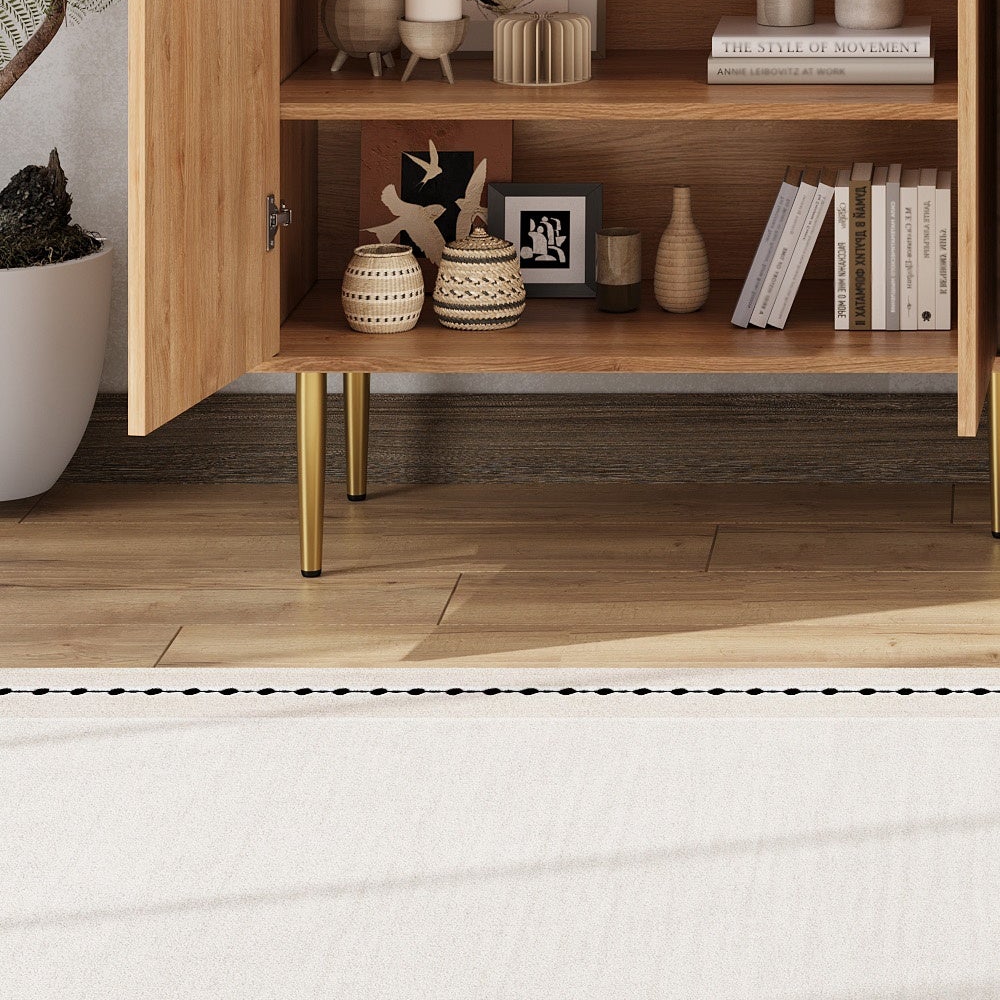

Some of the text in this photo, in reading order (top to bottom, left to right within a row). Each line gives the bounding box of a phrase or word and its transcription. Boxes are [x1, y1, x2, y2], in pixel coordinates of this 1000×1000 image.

[722, 41, 920, 53] THE STYLE OF MOVEMENT
[717, 68, 846, 76] ANNIE LEIBOVITZ AT WORK
